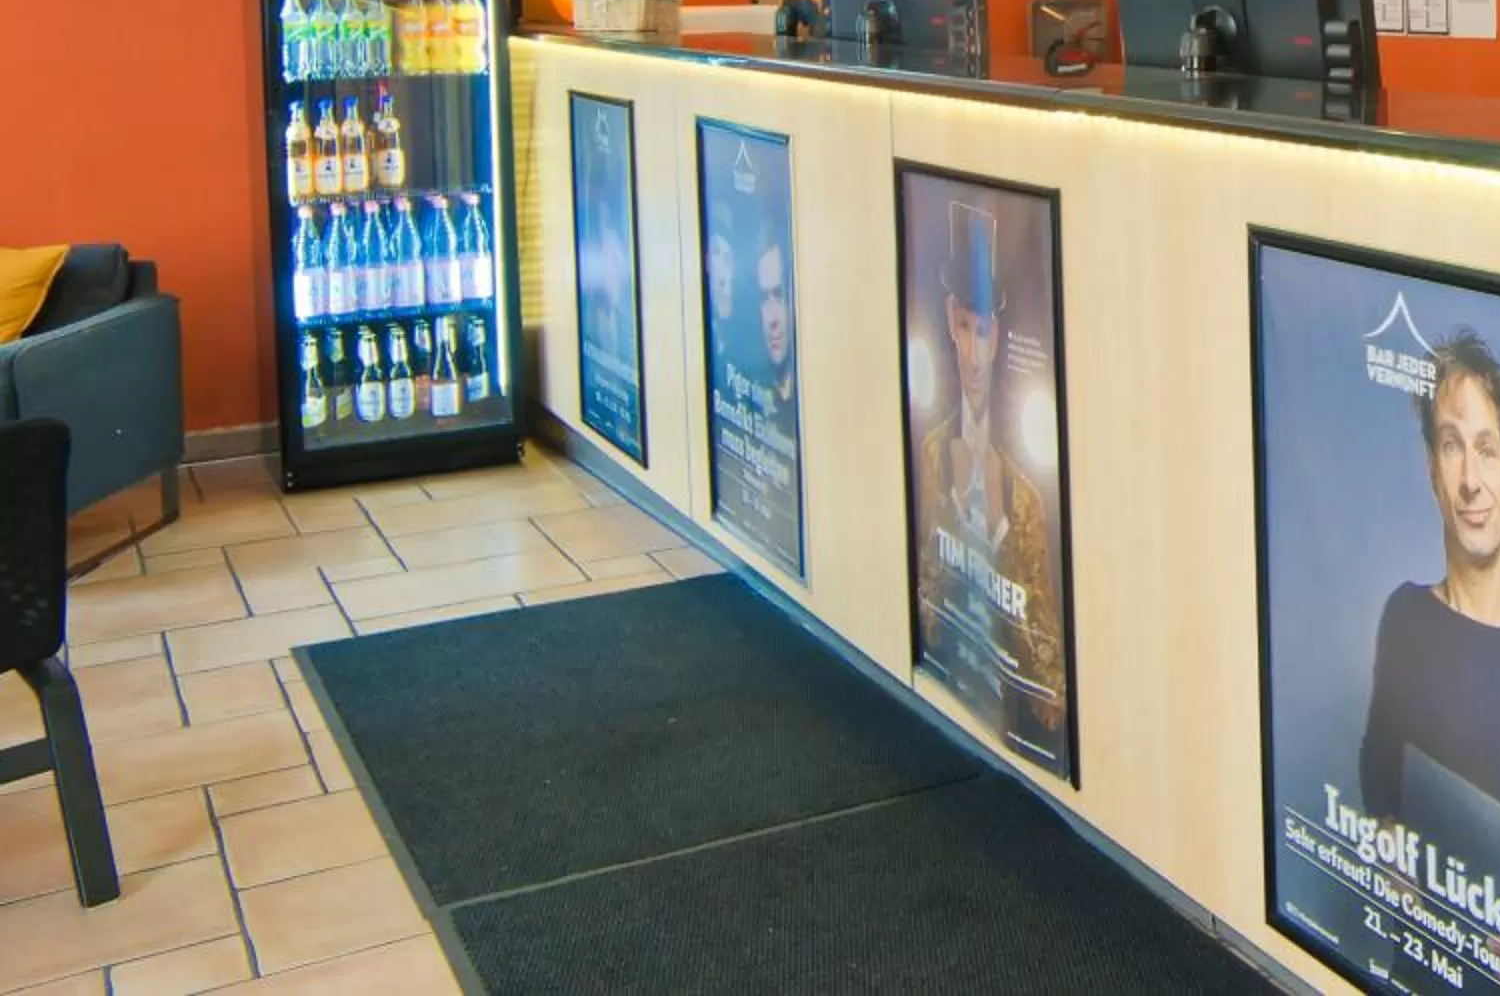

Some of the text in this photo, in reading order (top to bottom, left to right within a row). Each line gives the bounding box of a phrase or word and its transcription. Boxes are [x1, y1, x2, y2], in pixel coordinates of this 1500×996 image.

[1285, 818, 1316, 852] Sehr
[1318, 839, 1371, 891] erfreut!
[1373, 873, 1399, 907] Die
[1323, 783, 1419, 880] Ingolf
[1403, 932, 1430, 967] 23.
[1431, 949, 1463, 989] Mai
